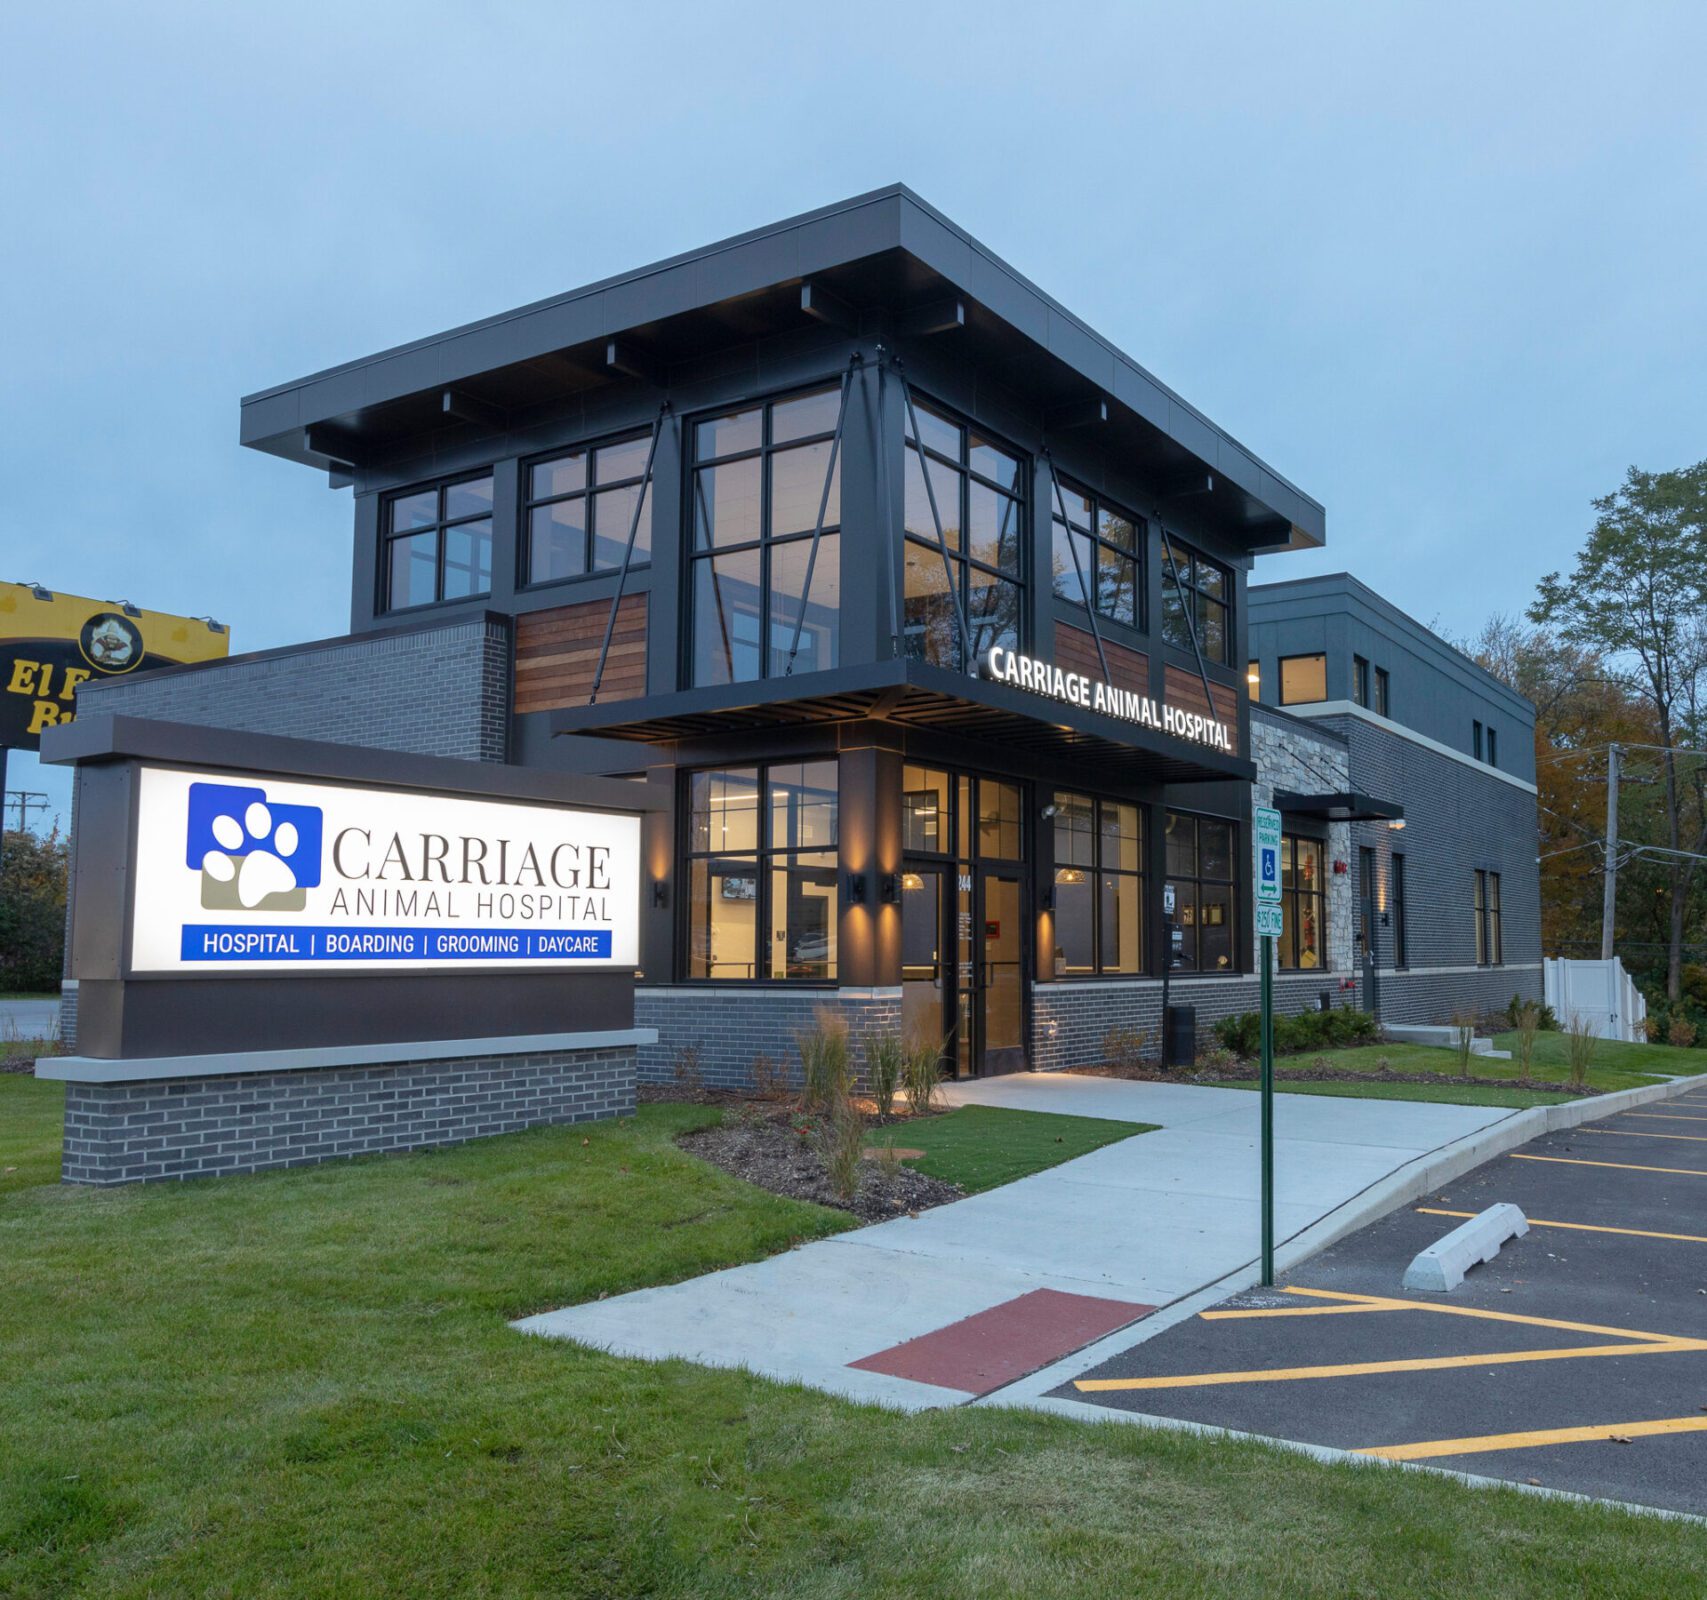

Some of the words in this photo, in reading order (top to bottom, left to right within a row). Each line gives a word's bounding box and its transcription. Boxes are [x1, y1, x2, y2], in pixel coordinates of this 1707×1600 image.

[6, 659, 53, 696] El
[59, 667, 99, 700] F
[988, 646, 1091, 707] CARRIAGE
[1093, 682, 1162, 729] ANIMAL
[1162, 704, 1232, 750] HOSPITAL
[1257, 816, 1279, 831] RESERVED
[1258, 832, 1278, 846] PARKING
[332, 827, 610, 890] CARRIAGE
[330, 887, 460, 918] ANIMAL
[477, 892, 612, 921] HOSPITAL
[1257, 911, 1270, 928] $250
[1271, 912, 1282, 929] FINE
[203, 933, 300, 953] HOSPITAL
[326, 934, 414, 953] BOARDING
[437, 935, 519, 953] GROOMING
[538, 936, 599, 953] DAYCARE
